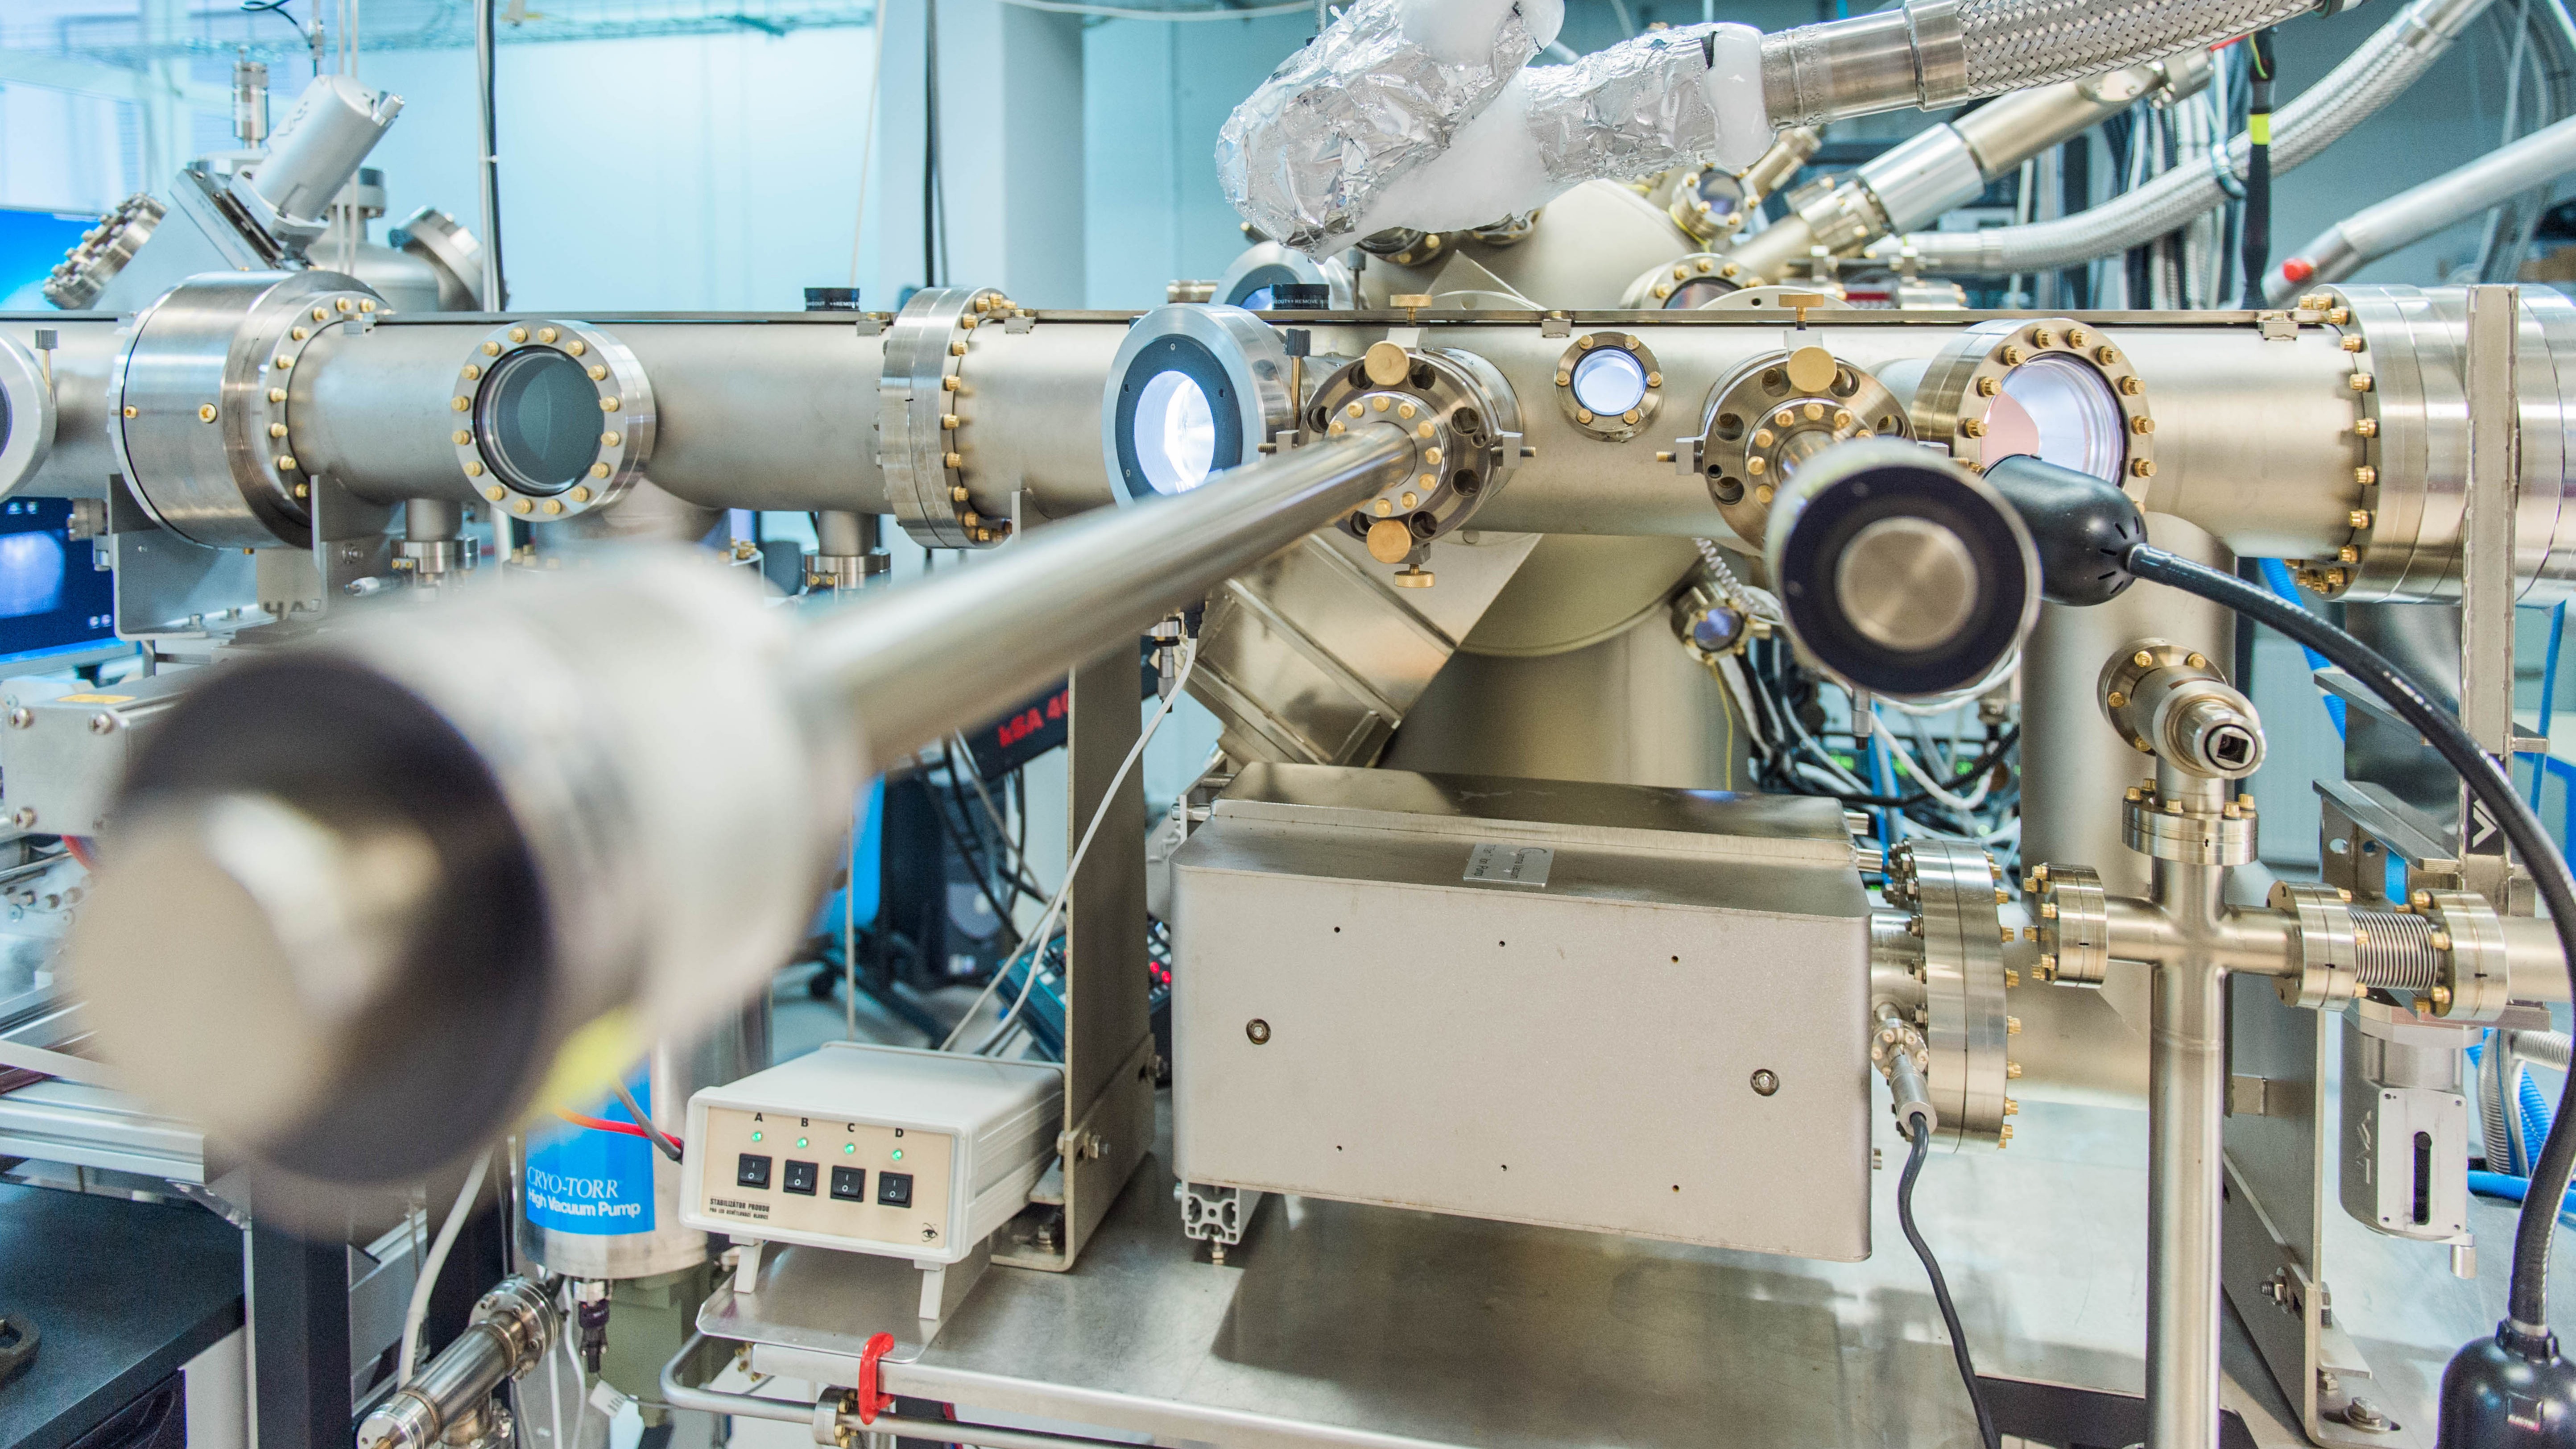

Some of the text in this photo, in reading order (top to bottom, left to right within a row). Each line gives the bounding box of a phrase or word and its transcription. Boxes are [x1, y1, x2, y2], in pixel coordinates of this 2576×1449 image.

[754, 1112, 763, 1122] A
[801, 1118, 809, 1127] B
[848, 1123, 855, 1132] C
[895, 1128, 904, 1138] D
[527, 1166, 619, 1199] CRYO-TORR
[528, 1186, 641, 1218] High Vacuum Pump
